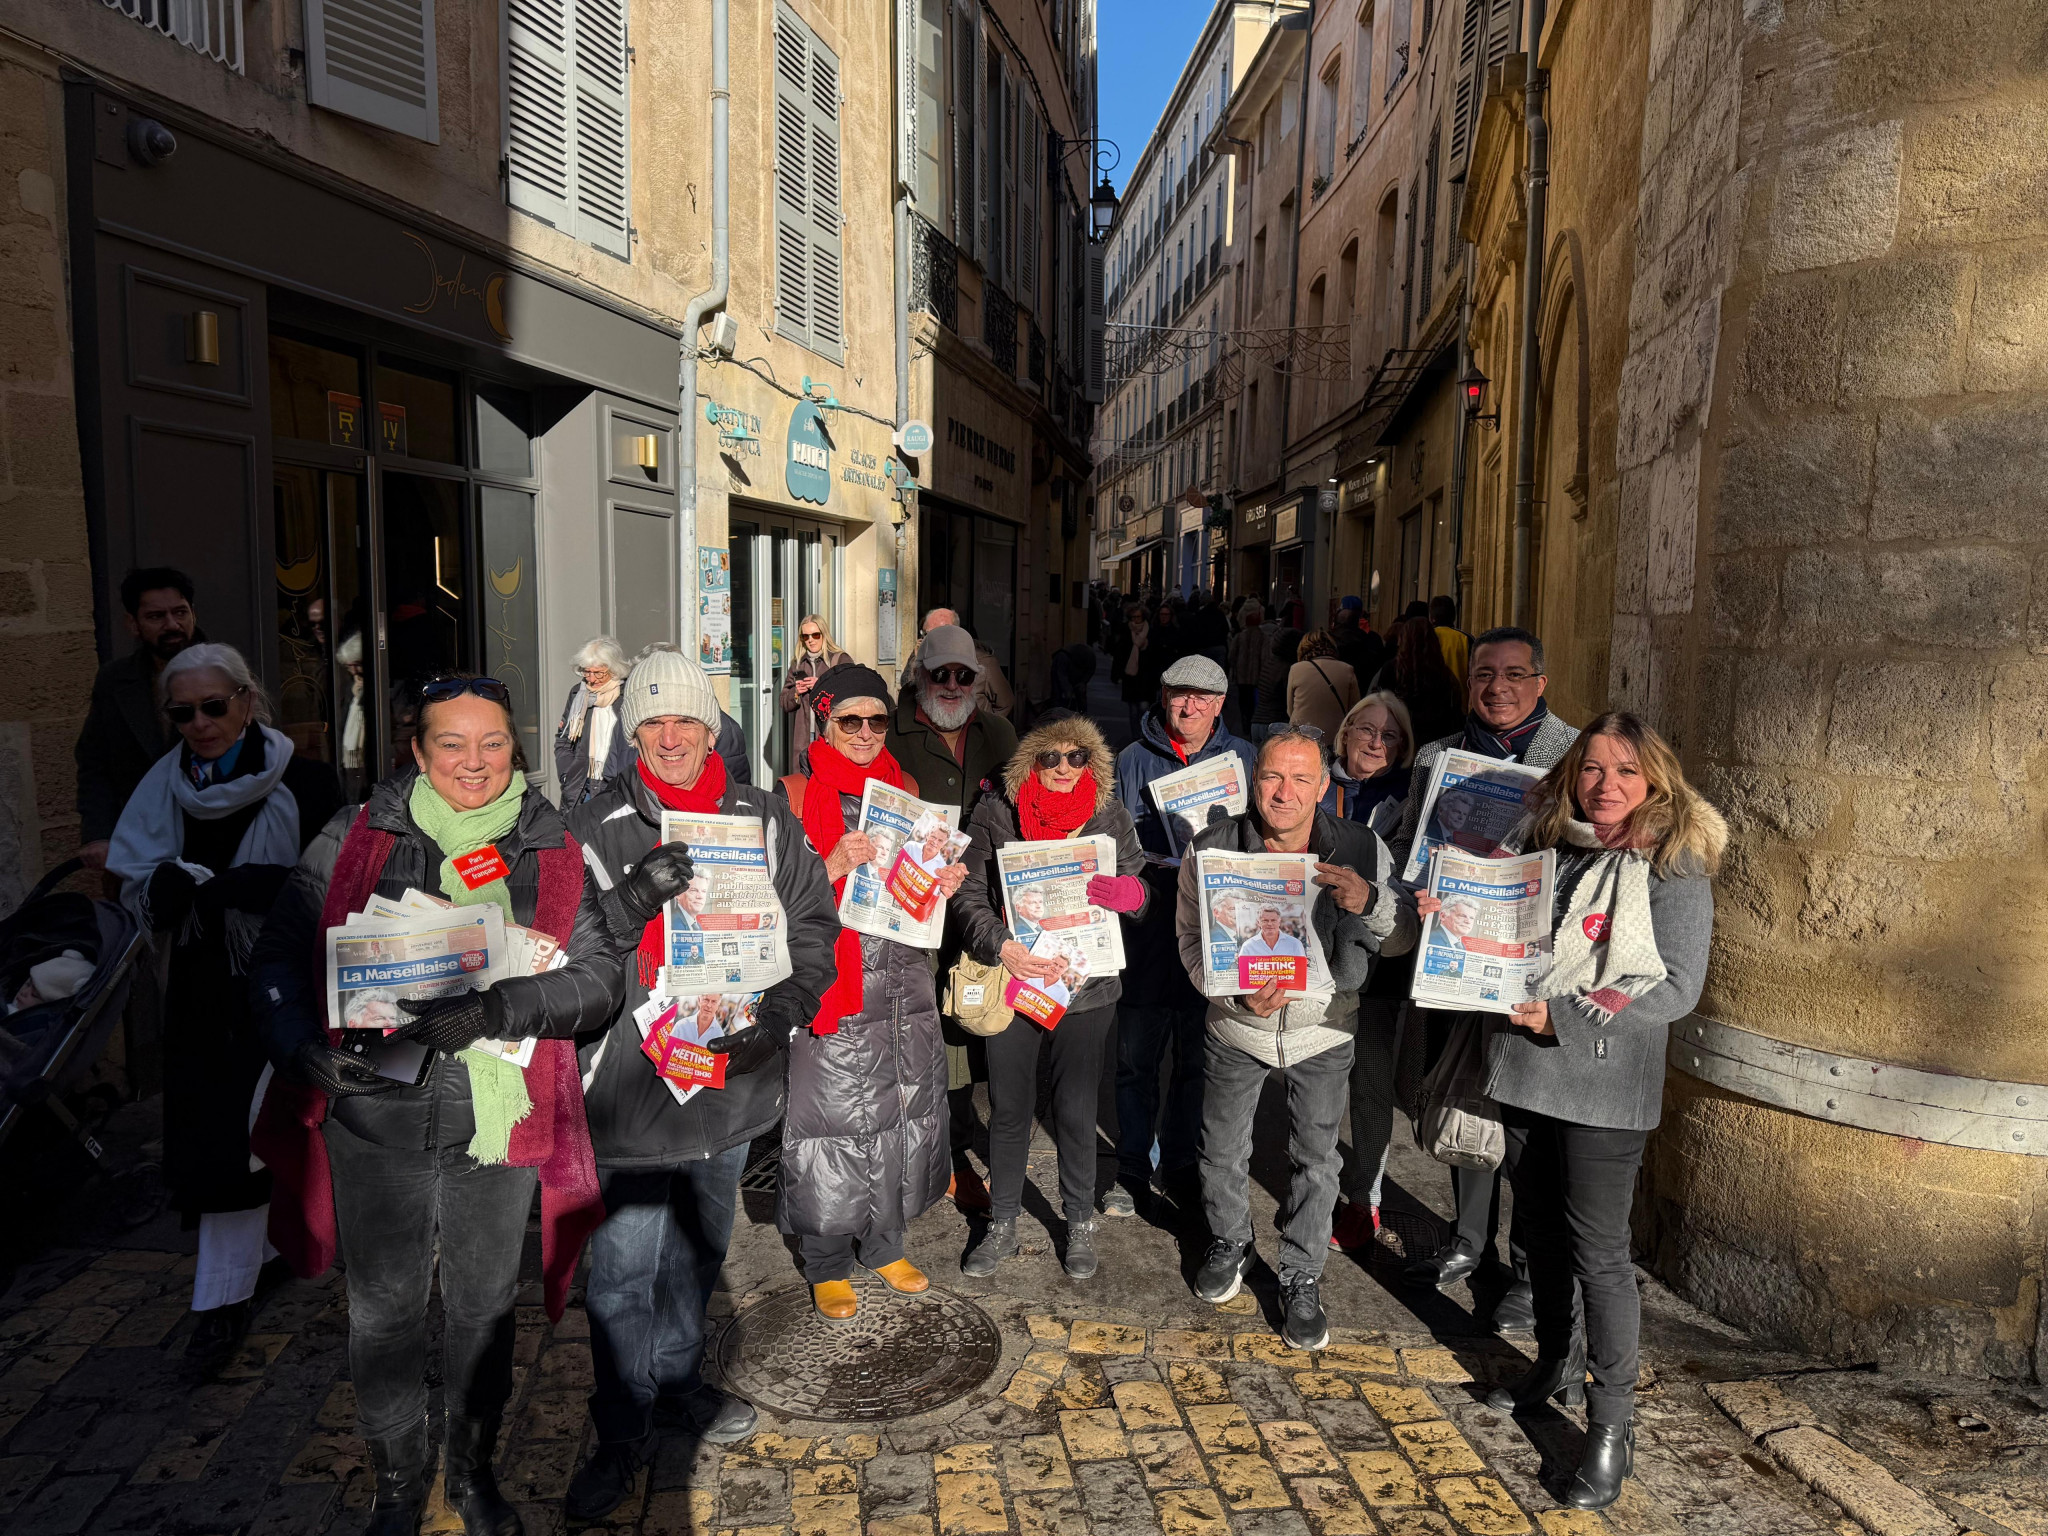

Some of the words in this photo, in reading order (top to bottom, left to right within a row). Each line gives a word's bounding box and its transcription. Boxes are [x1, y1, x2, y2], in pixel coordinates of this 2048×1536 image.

[718, 430, 760, 457] COCA
[947, 417, 985, 458] PIERRE
[986, 440, 1016, 474] HERMÉ
[792, 440, 828, 471] RAUGI
[974, 475, 993, 492] PARIS
[651, 685, 657, 693] B
[1445, 774, 1457, 785] La
[1458, 778, 1521, 800] Marseillaise
[1177, 788, 1226, 808] Marseillaise
[869, 807, 879, 819] La
[468, 854, 484, 865] Parti
[687, 847, 764, 862] Marseillaise
[460, 857, 499, 876] communiste
[471, 866, 497, 880] français
[900, 857, 933, 889] MEETING
[1007, 873, 1020, 883] La
[1021, 864, 1080, 880] Marseillaise
[1207, 876, 1221, 886] La
[1222, 875, 1285, 892] Marseillaise
[1441, 878, 1456, 889] La
[1457, 881, 1526, 897] Marseillaise
[343, 970, 362, 983] La
[365, 960, 459, 981] Marseillaise
[1248, 961, 1296, 970] MEETING
[408, 990, 433, 1001] Des
[1019, 987, 1055, 1013] MEETING
[671, 1045, 715, 1067] MEETING
[665, 1069, 692, 1080] MARSEILLE
[684, 1060, 714, 1072] NOVEMBRE
[694, 1069, 712, 1078] 13H30
